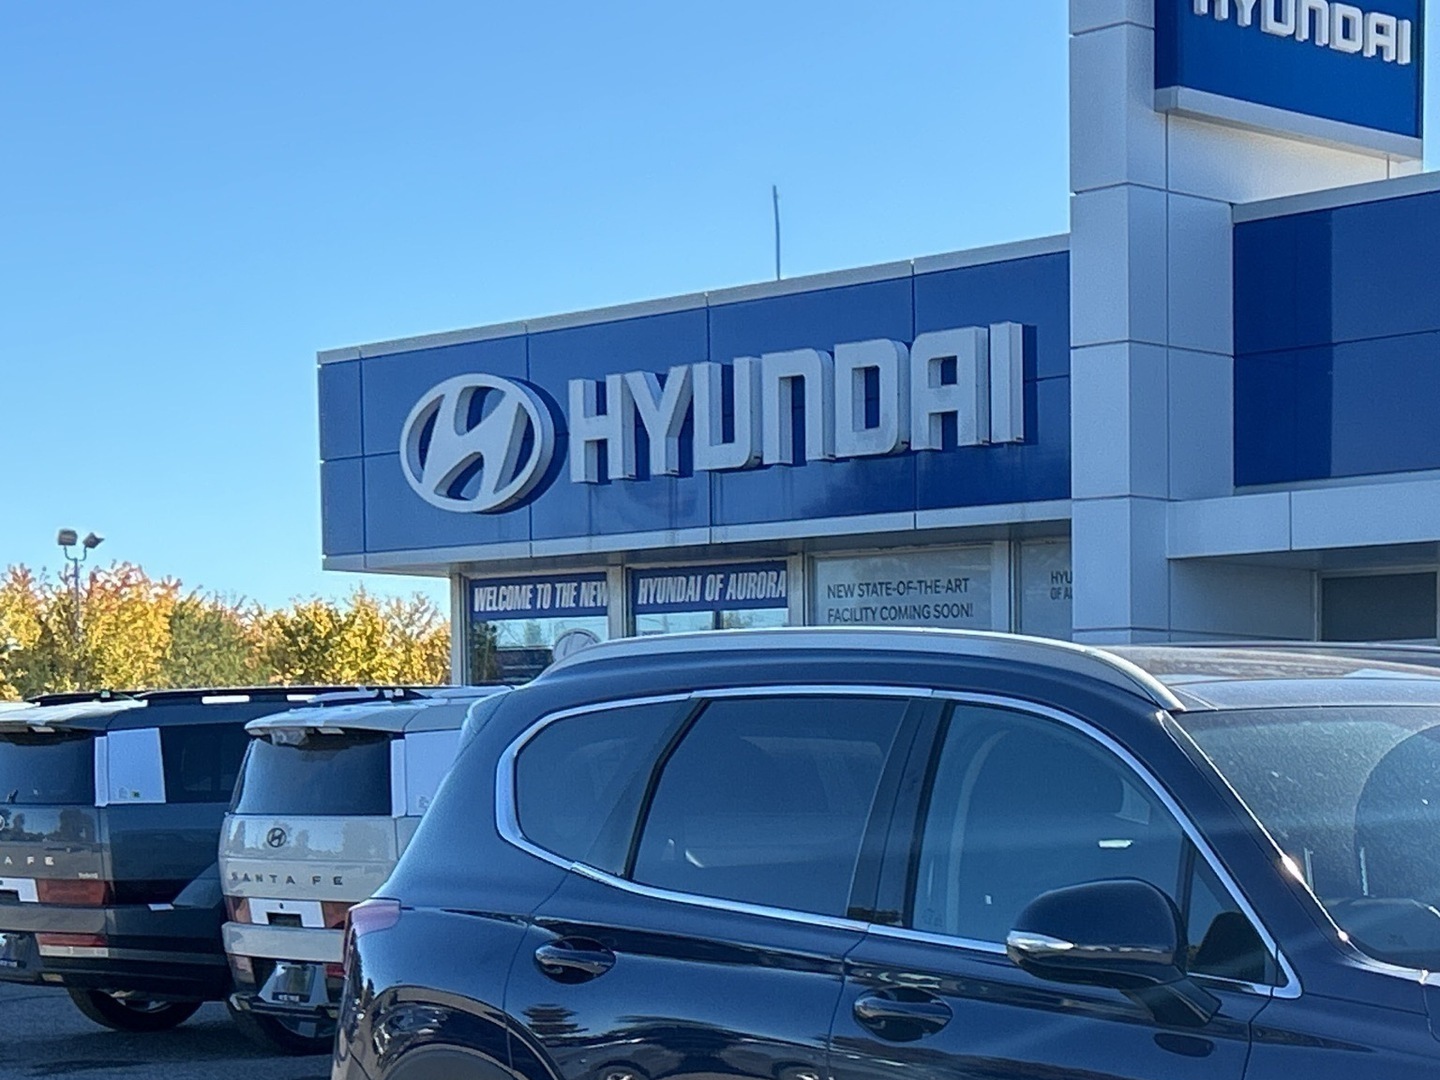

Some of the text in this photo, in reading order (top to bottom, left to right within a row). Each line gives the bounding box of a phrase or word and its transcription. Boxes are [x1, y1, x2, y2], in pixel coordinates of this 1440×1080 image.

[568, 321, 1025, 483] HYUNDAI
[473, 584, 533, 612] WELCOME
[536, 583, 552, 610] TO
[554, 581, 578, 608] THE
[637, 570, 786, 605] HYUNDAI OF AURORA
[827, 577, 970, 599] NEW STATE-OF-THE-ART
[827, 602, 974, 623] FACILITY COMING SOON!
[231, 871, 344, 887] SANTA FE
